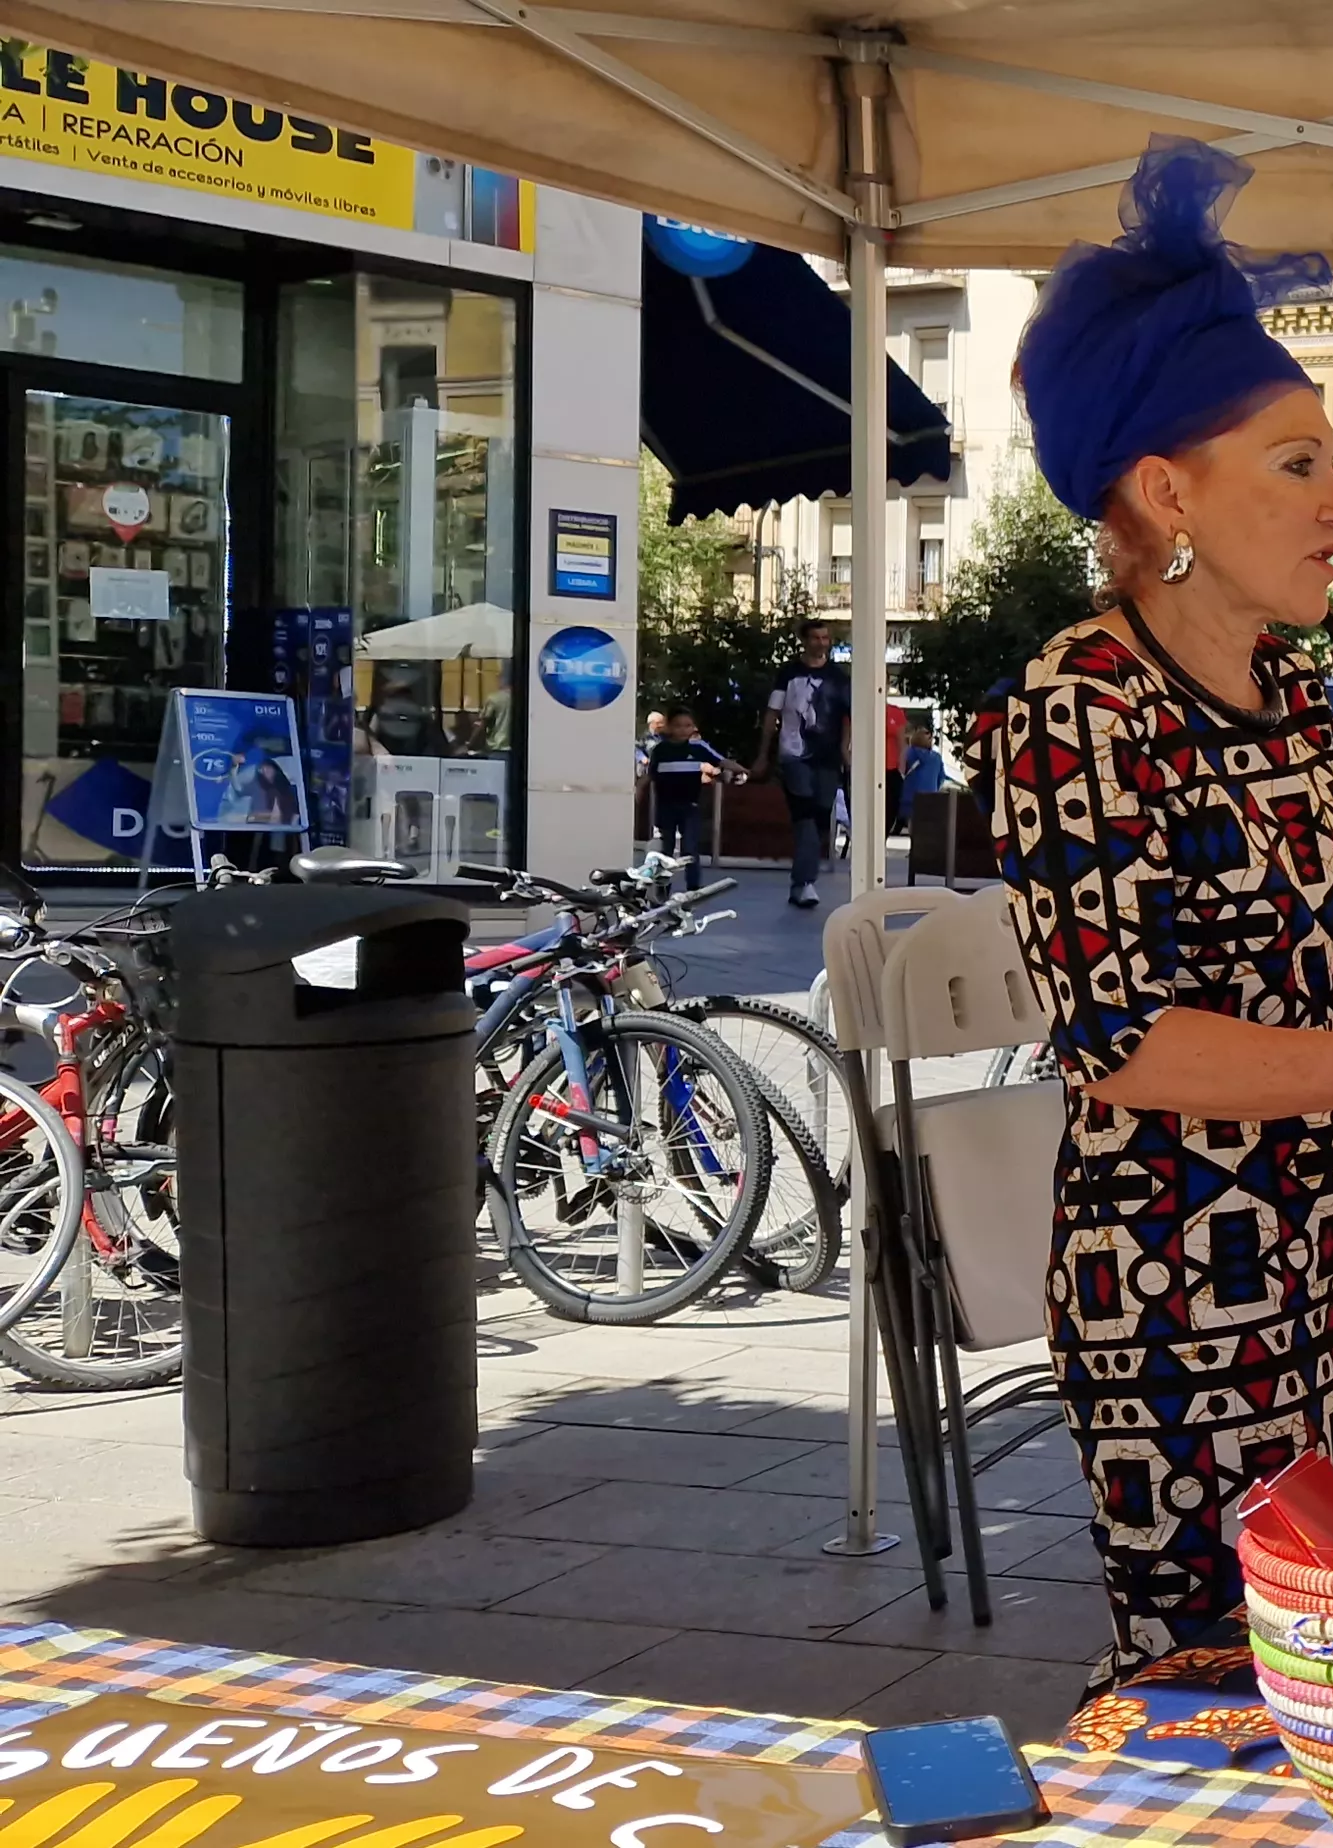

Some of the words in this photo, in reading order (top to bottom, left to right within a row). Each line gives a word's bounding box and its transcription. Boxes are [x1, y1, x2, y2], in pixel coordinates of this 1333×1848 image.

[63, 113, 244, 167] REPARACIÓN
[116, 67, 375, 165] HOUSE
[87, 149, 138, 171] Venta
[142, 160, 164, 176] de
[168, 167, 253, 193] accesorios
[256, 184, 267, 199] y
[270, 185, 330, 209] móviles
[333, 198, 377, 217] libres
[544, 658, 621, 678] DIGI
[254, 705, 281, 715] DIGI
[487, 1747, 684, 1810] DE
